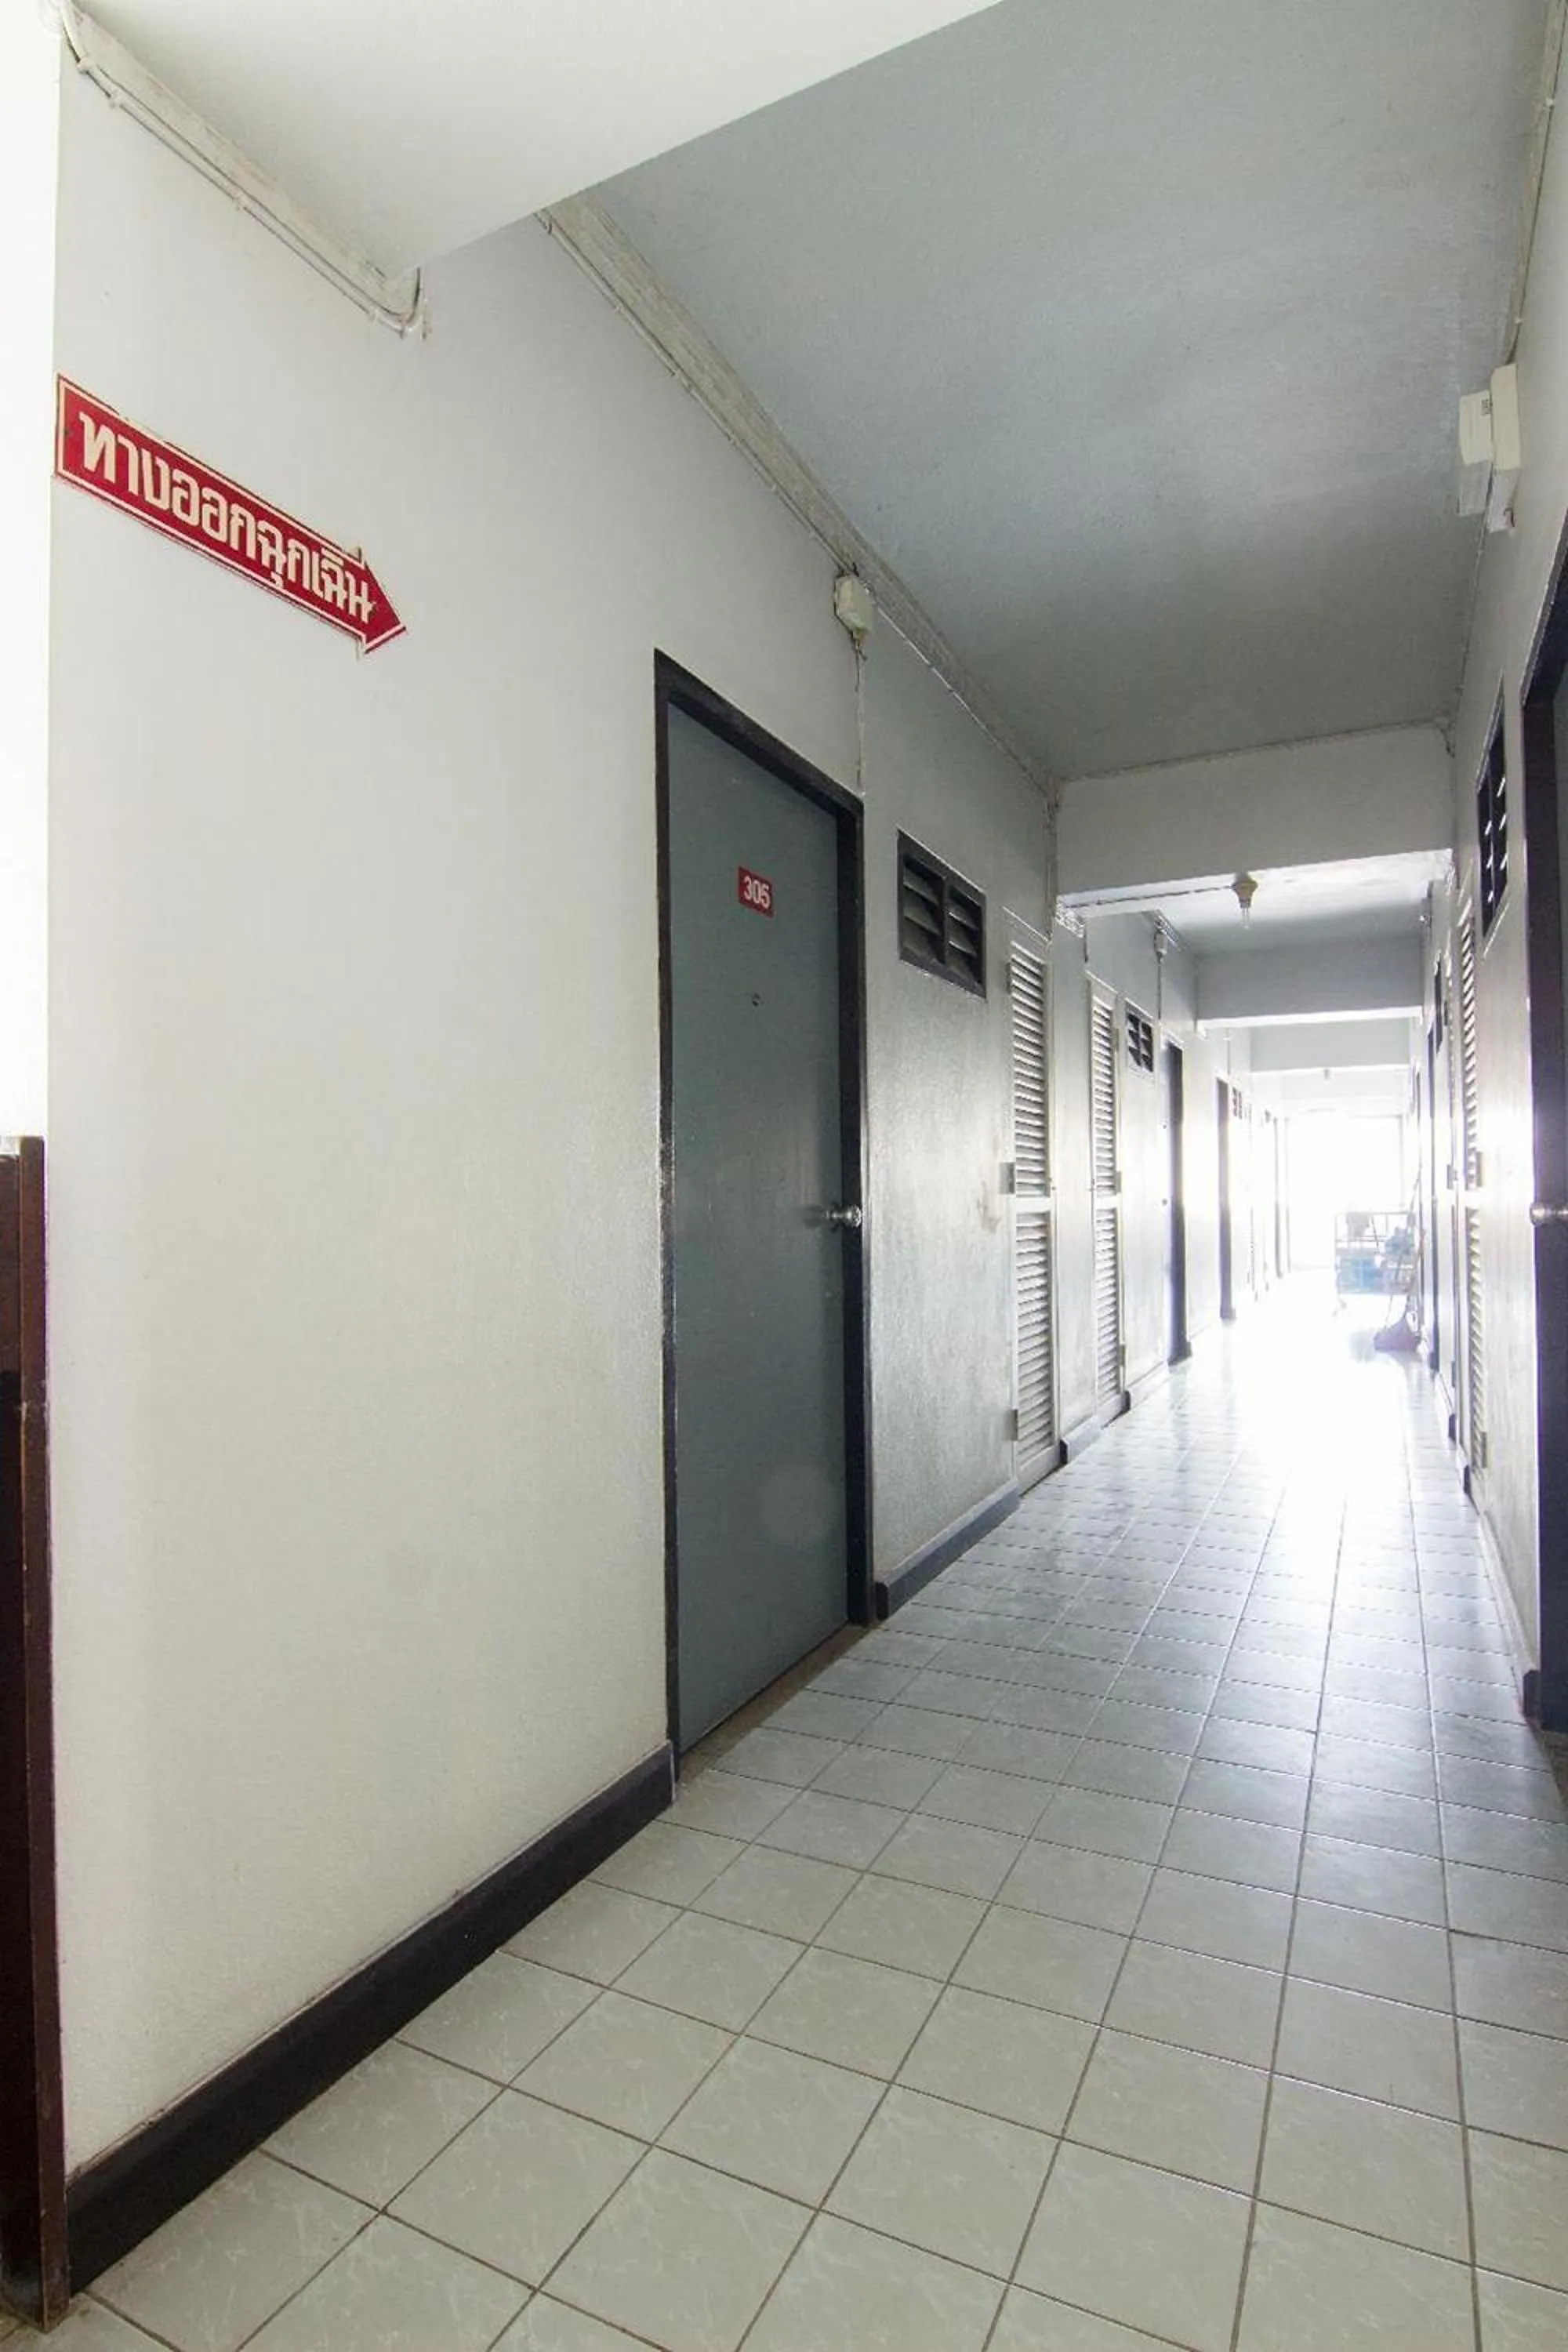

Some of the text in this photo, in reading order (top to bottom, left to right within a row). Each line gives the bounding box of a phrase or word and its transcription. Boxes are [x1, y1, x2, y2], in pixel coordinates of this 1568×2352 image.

[79, 410, 377, 622] ทางออกฉุกเฉิน
[743, 874, 771, 909] 305
